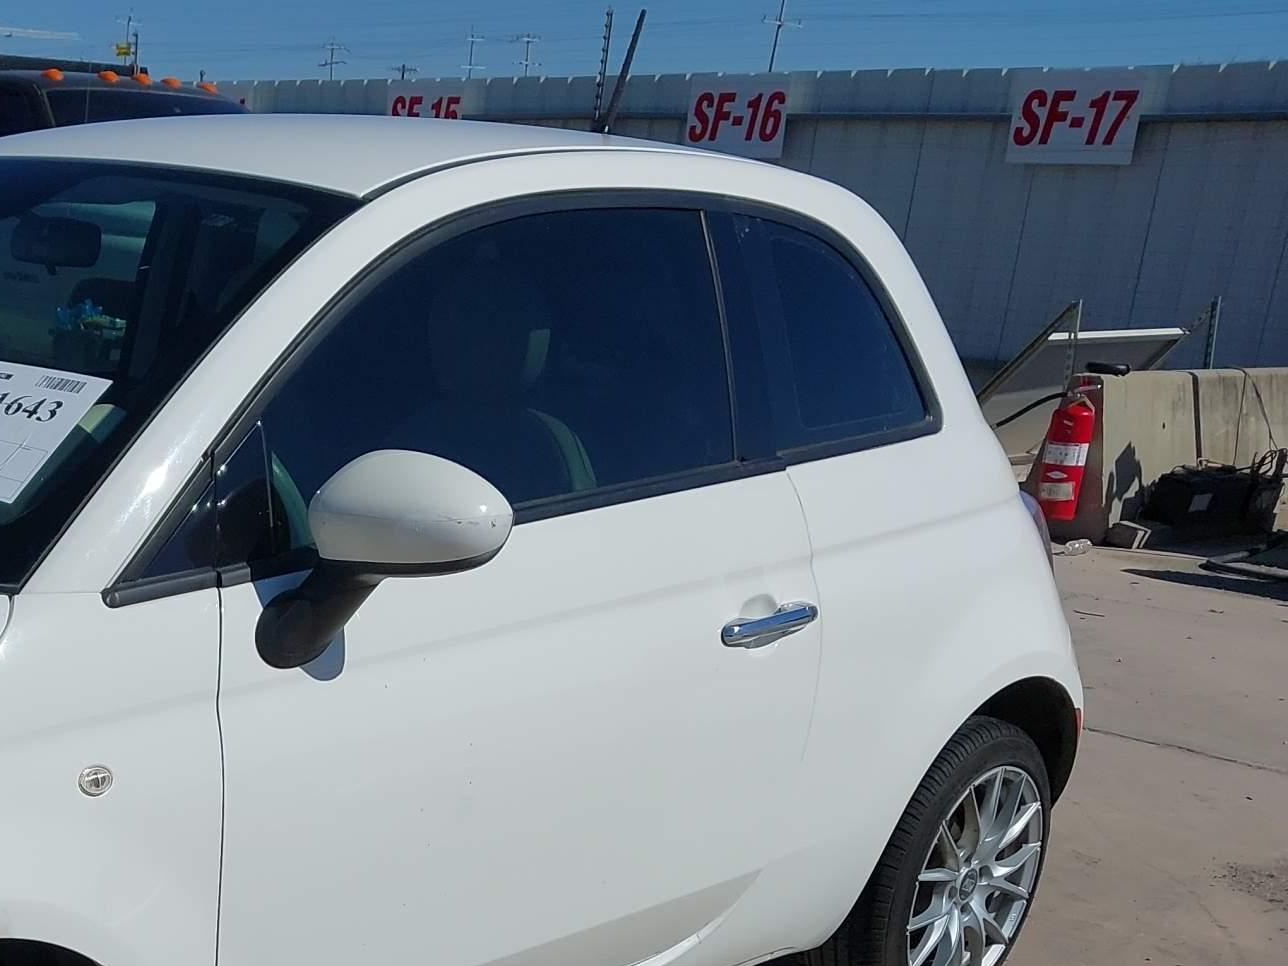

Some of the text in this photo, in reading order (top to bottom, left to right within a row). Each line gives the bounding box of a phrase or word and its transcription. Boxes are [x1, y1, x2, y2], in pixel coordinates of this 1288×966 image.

[391, 95, 461, 119] SF15
[688, 91, 787, 142] SF-16
[1013, 89, 1140, 146] SF-17
